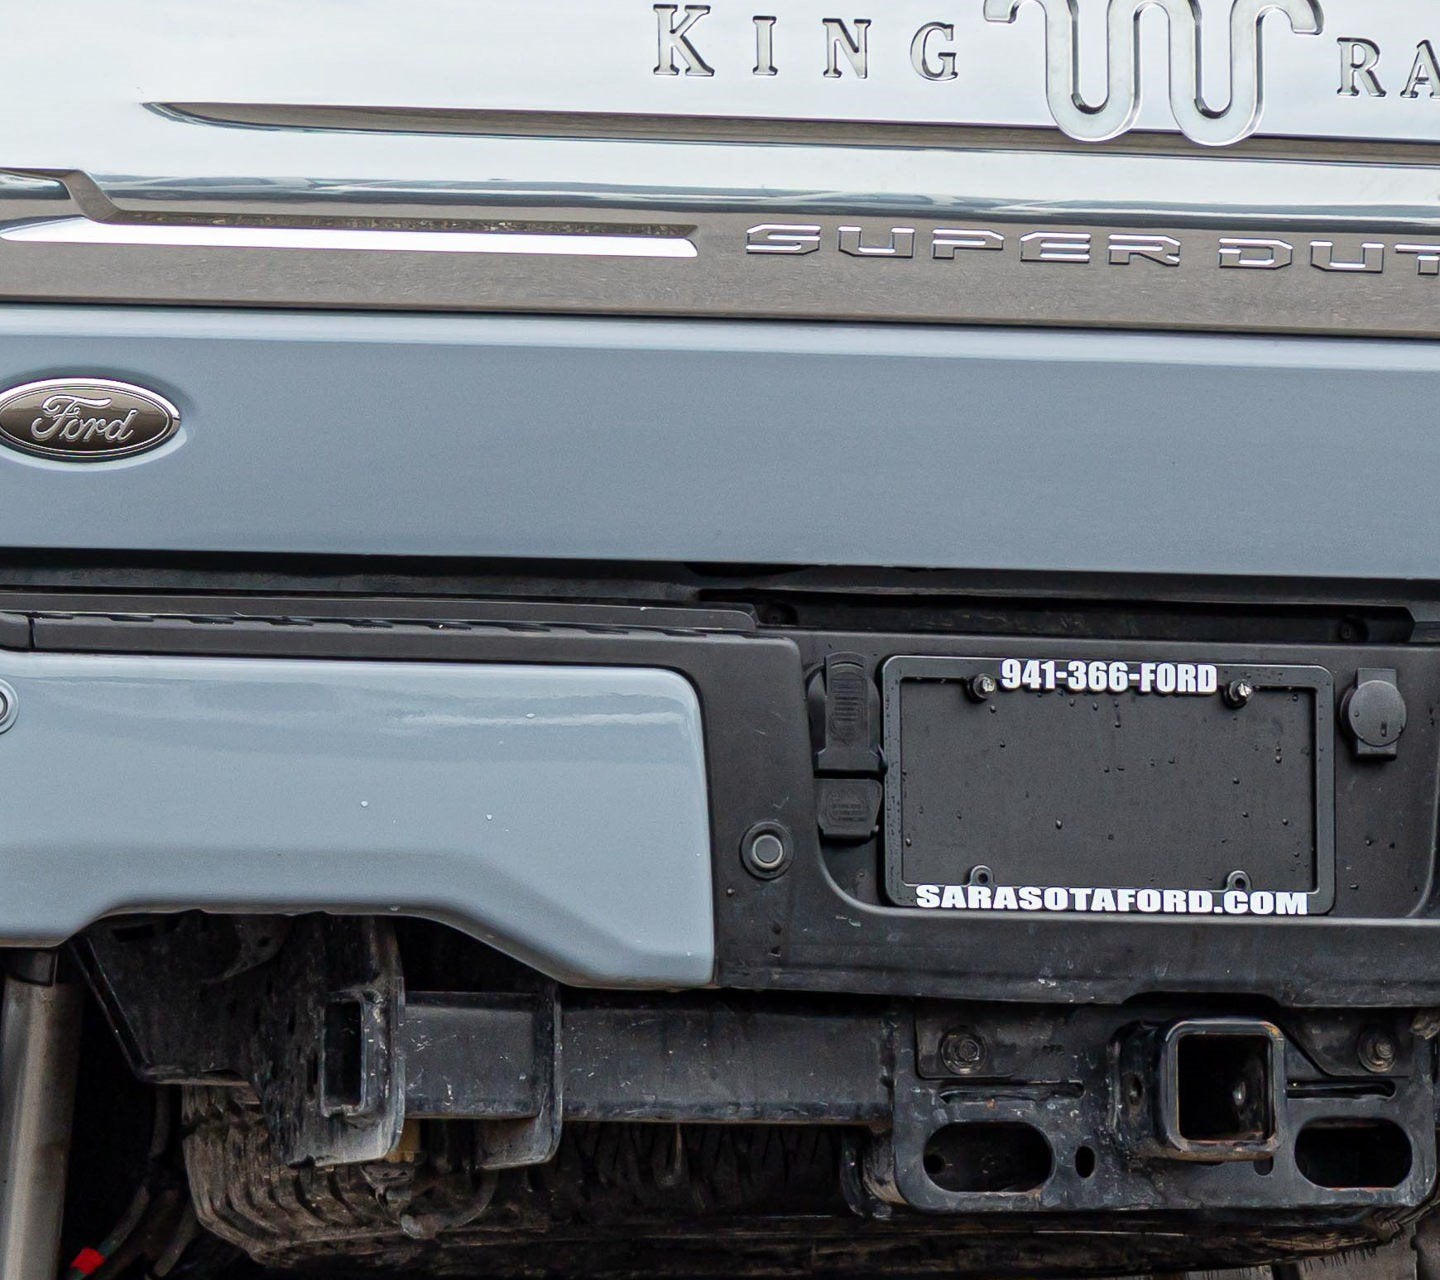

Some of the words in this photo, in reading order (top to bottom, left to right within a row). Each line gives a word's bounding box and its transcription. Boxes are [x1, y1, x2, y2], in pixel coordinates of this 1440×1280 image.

[651, 2, 960, 82] KING
[745, 222, 1182, 269] SUPER
[30, 393, 139, 443] Ford
[1000, 658, 1218, 695] 941-366-FORD
[915, 884, 1309, 915] SARASOTAFORD.COM
